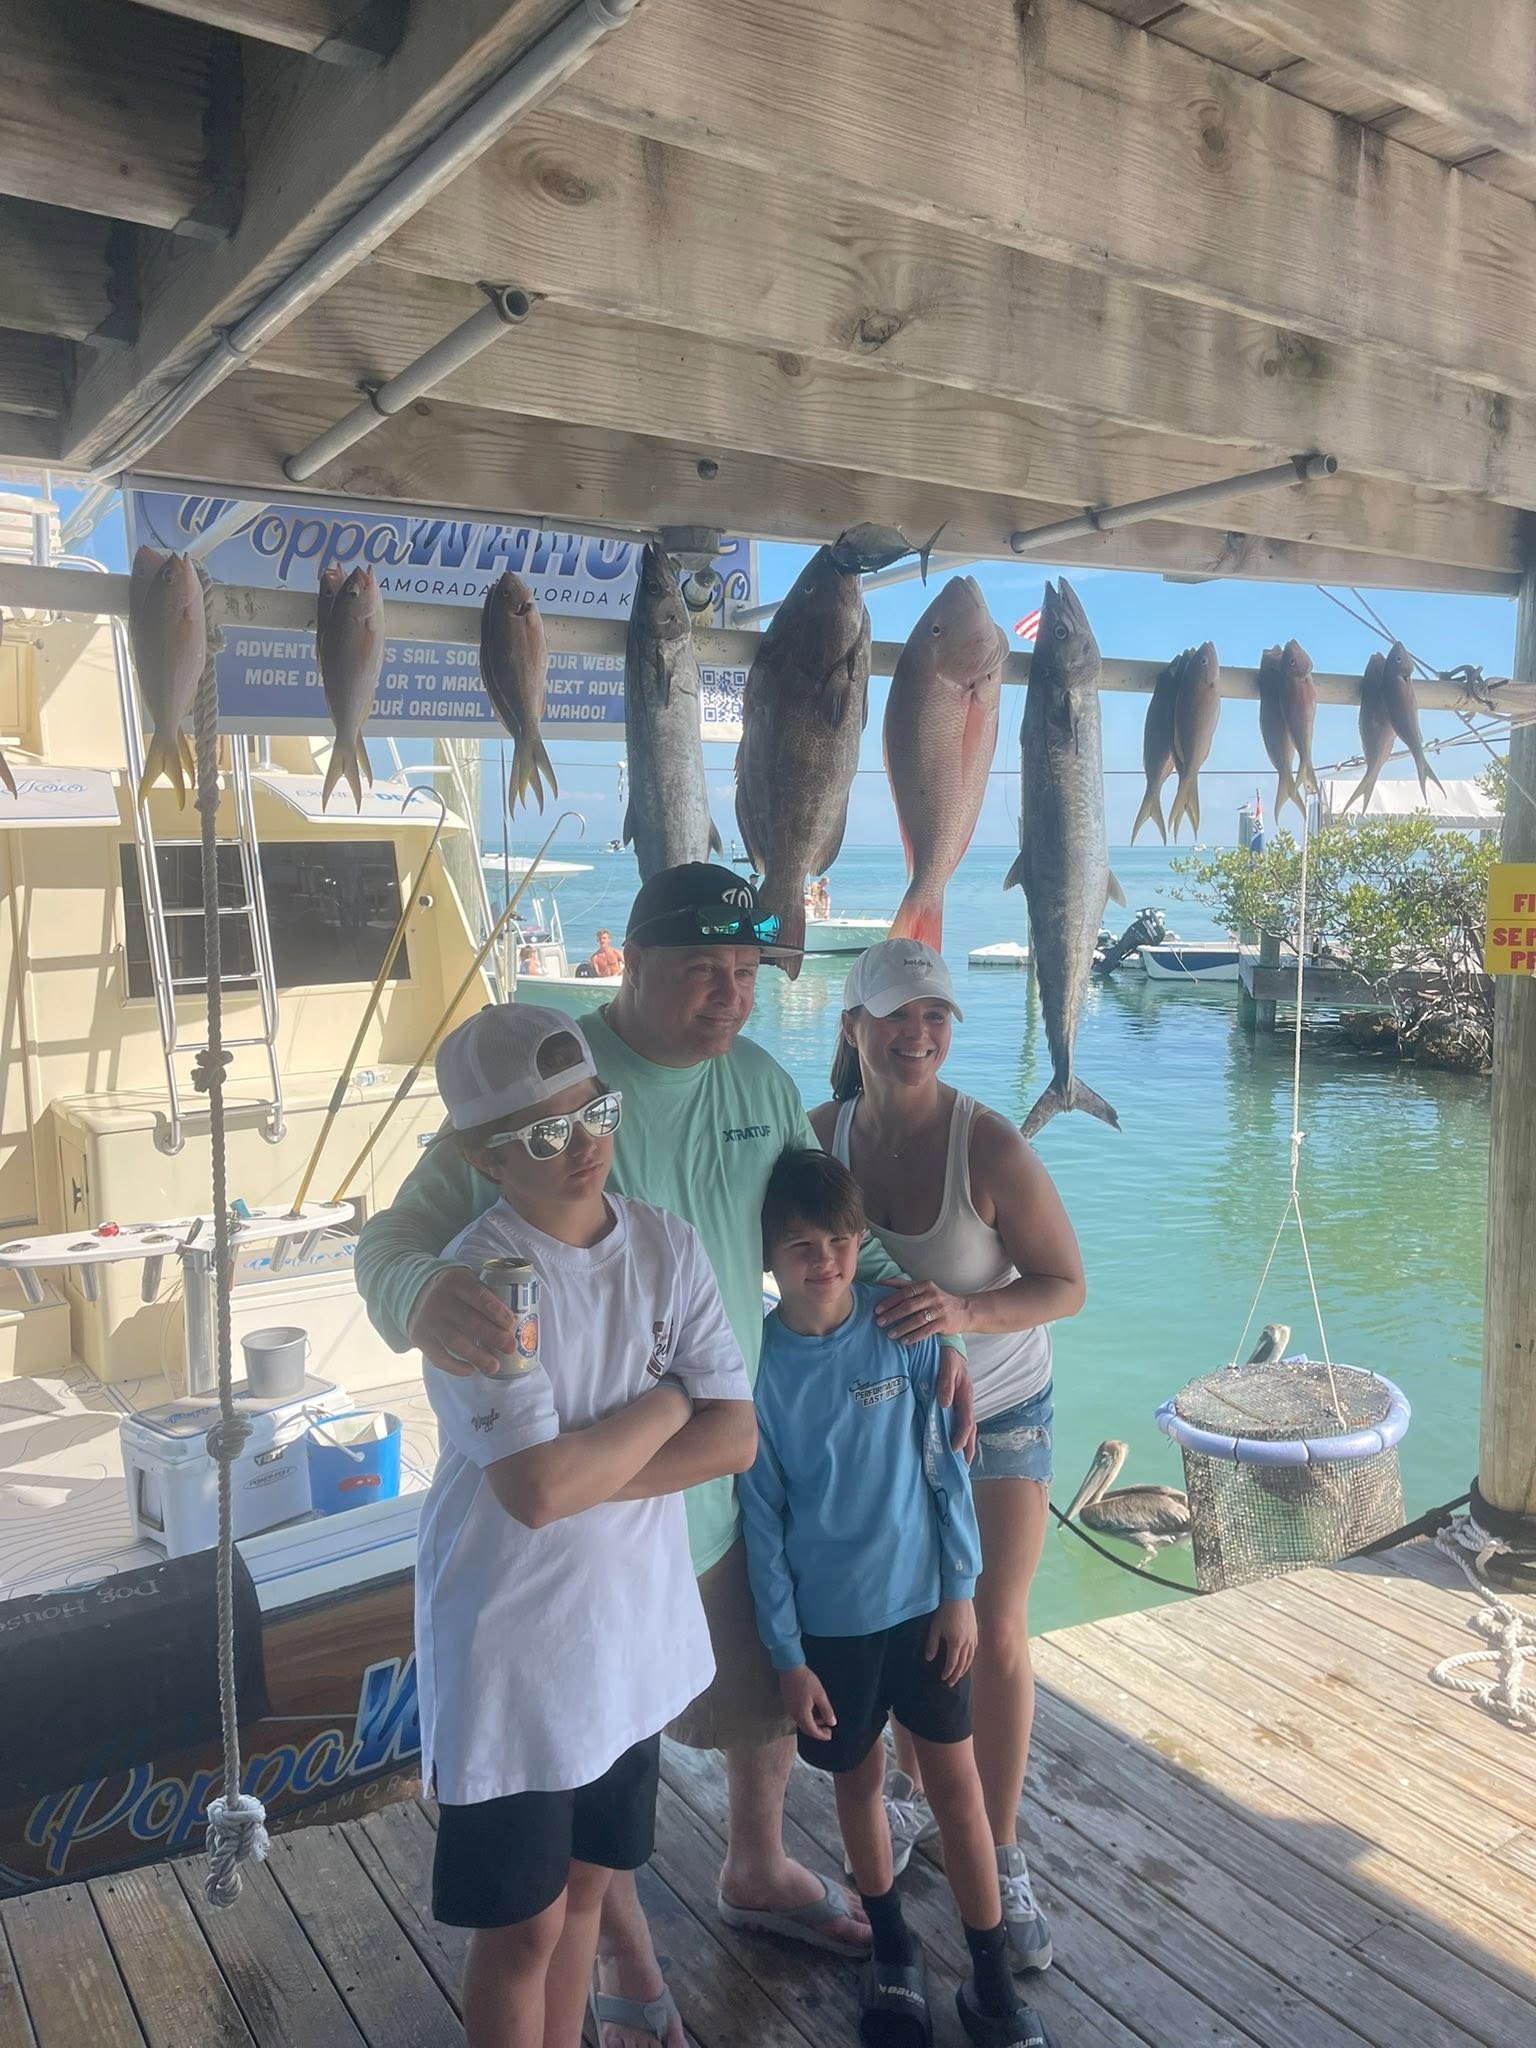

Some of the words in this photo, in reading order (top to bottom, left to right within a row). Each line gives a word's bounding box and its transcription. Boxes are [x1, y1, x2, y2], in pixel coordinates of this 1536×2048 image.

[379, 577, 489, 597] AMORADA
[533, 588, 608, 605] LORIDA
[236, 640, 317, 660] ADVENT
[402, 648, 439, 664] SAIL
[445, 650, 480, 666] SOO
[583, 656, 624, 671] WEBS
[245, 669, 299, 686] MORE
[386, 673, 408, 690] OR
[414, 675, 436, 690] TO
[409, 701, 485, 718] ORIGINAL
[547, 704, 605, 720] WAHOO!
[510, 1281, 540, 1314] Lit
[272, 1767, 420, 1832] SLAMORA
